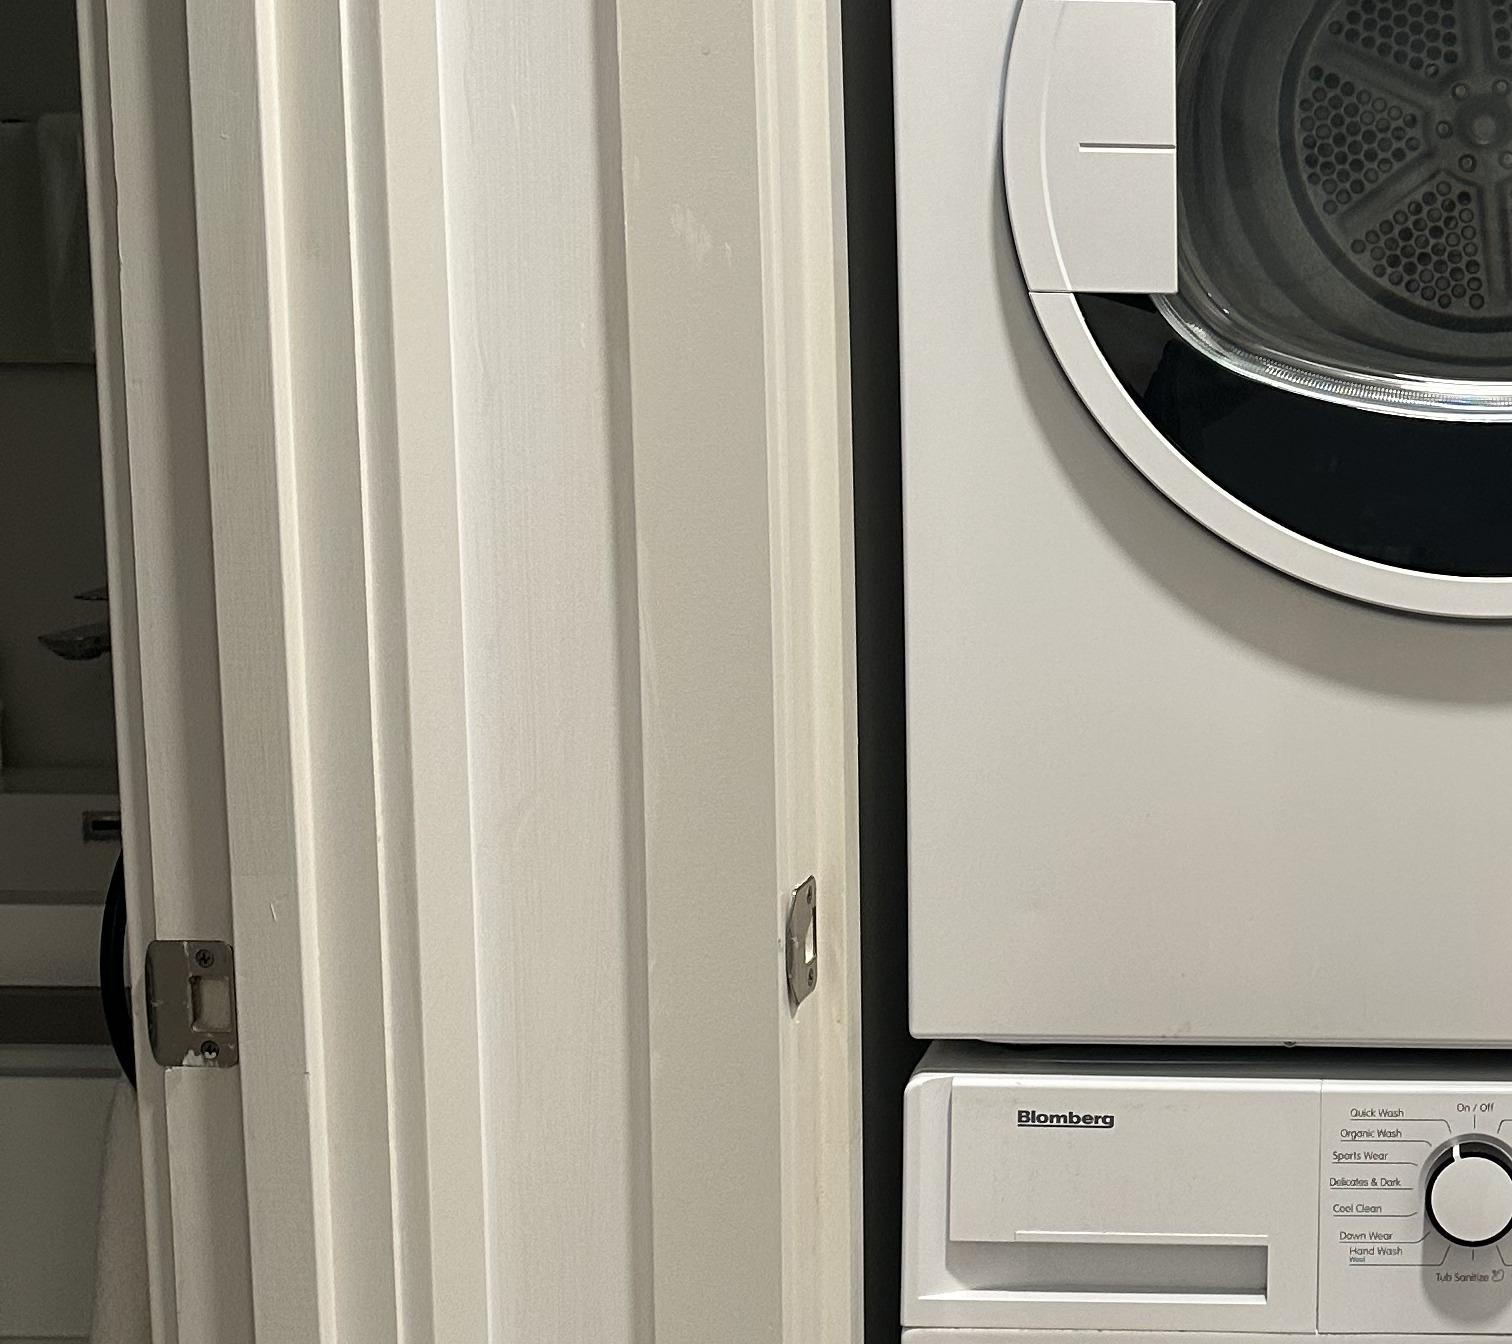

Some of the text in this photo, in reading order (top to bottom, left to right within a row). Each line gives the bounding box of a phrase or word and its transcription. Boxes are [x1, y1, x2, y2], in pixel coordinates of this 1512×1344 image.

[1456, 1102, 1470, 1112] On
[1480, 1102, 1495, 1112] Off
[1350, 1108, 1404, 1118] Quick Wash
[1017, 1110, 1115, 1128] Blomberg
[1340, 1128, 1402, 1140] Organic Wash
[1332, 1151, 1388, 1163] Sports Wear
[1329, 1177, 1402, 1187] Delicates & Dark
[1332, 1203, 1382, 1213] Cool Clean
[1339, 1231, 1393, 1241] Down Wear
[1350, 1246, 1403, 1256] Hand Wash
[1435, 1272, 1490, 1282] Tub Sanitize
